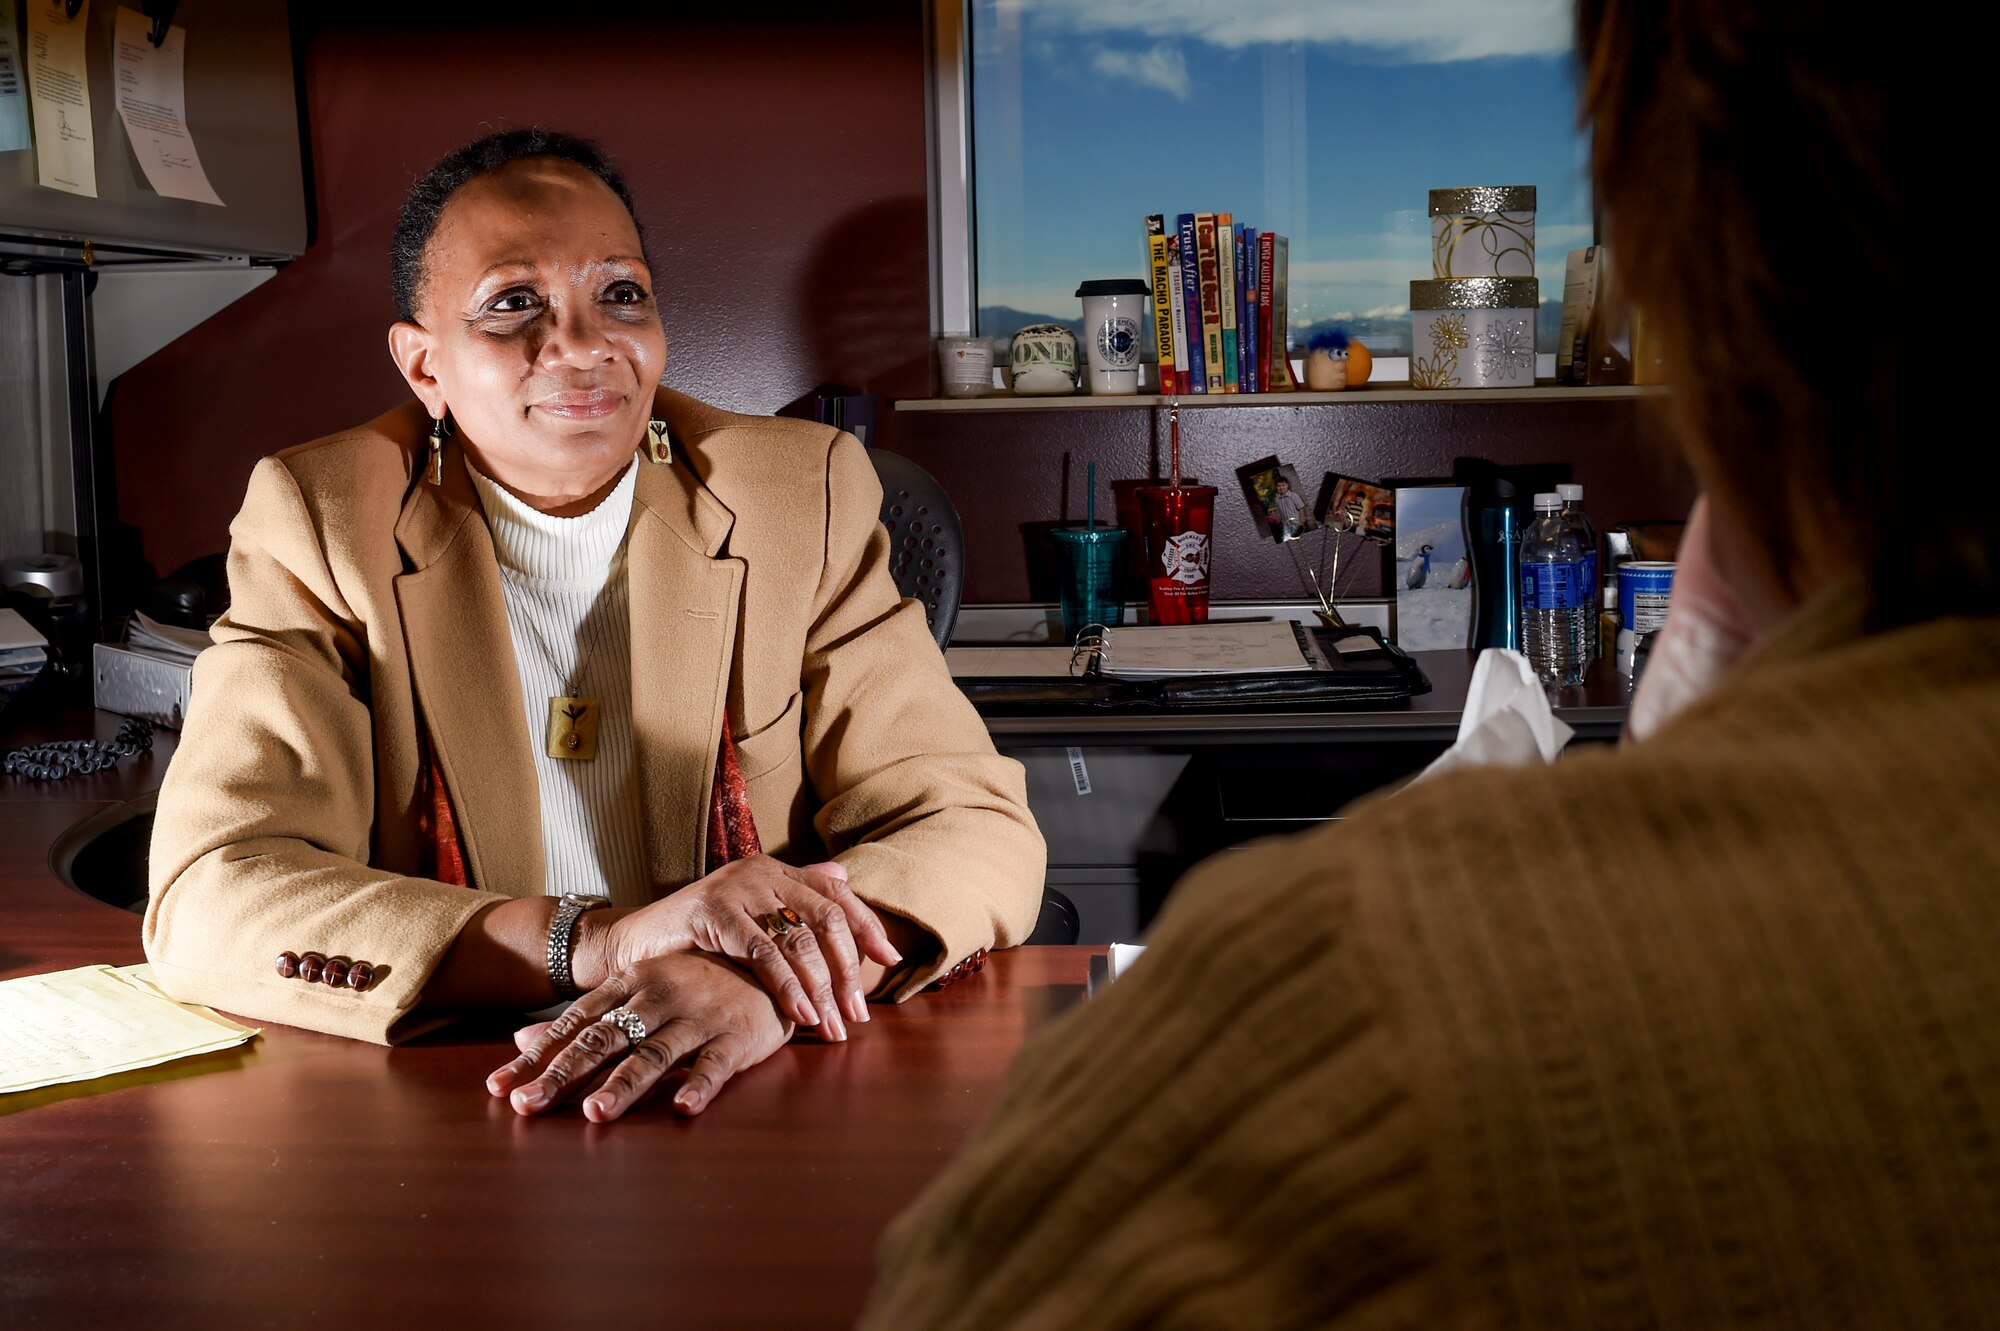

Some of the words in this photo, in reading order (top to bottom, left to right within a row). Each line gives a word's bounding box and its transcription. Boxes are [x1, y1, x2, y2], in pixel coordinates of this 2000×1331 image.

[1153, 242, 1164, 262] THE
[1182, 222, 1194, 255] Trust
[1198, 223, 1215, 258] Can't
[1221, 229, 1230, 266] Understanding
[1262, 242, 1271, 260] NEVER
[1173, 271, 1181, 295] TRAUMA
[1184, 258, 1198, 292] After
[1200, 259, 1216, 282] Get
[1261, 261, 1270, 284] CALLED
[1155, 266, 1168, 305] MACHO
[1202, 283, 1218, 313] Over
[1260, 291, 1270, 307] RAPE
[1189, 294, 1200, 343] Trauma
[1158, 308, 1172, 358] PARADOX
[1014, 341, 1073, 367] ONE
[1178, 535, 1202, 543] BUCKLEY
